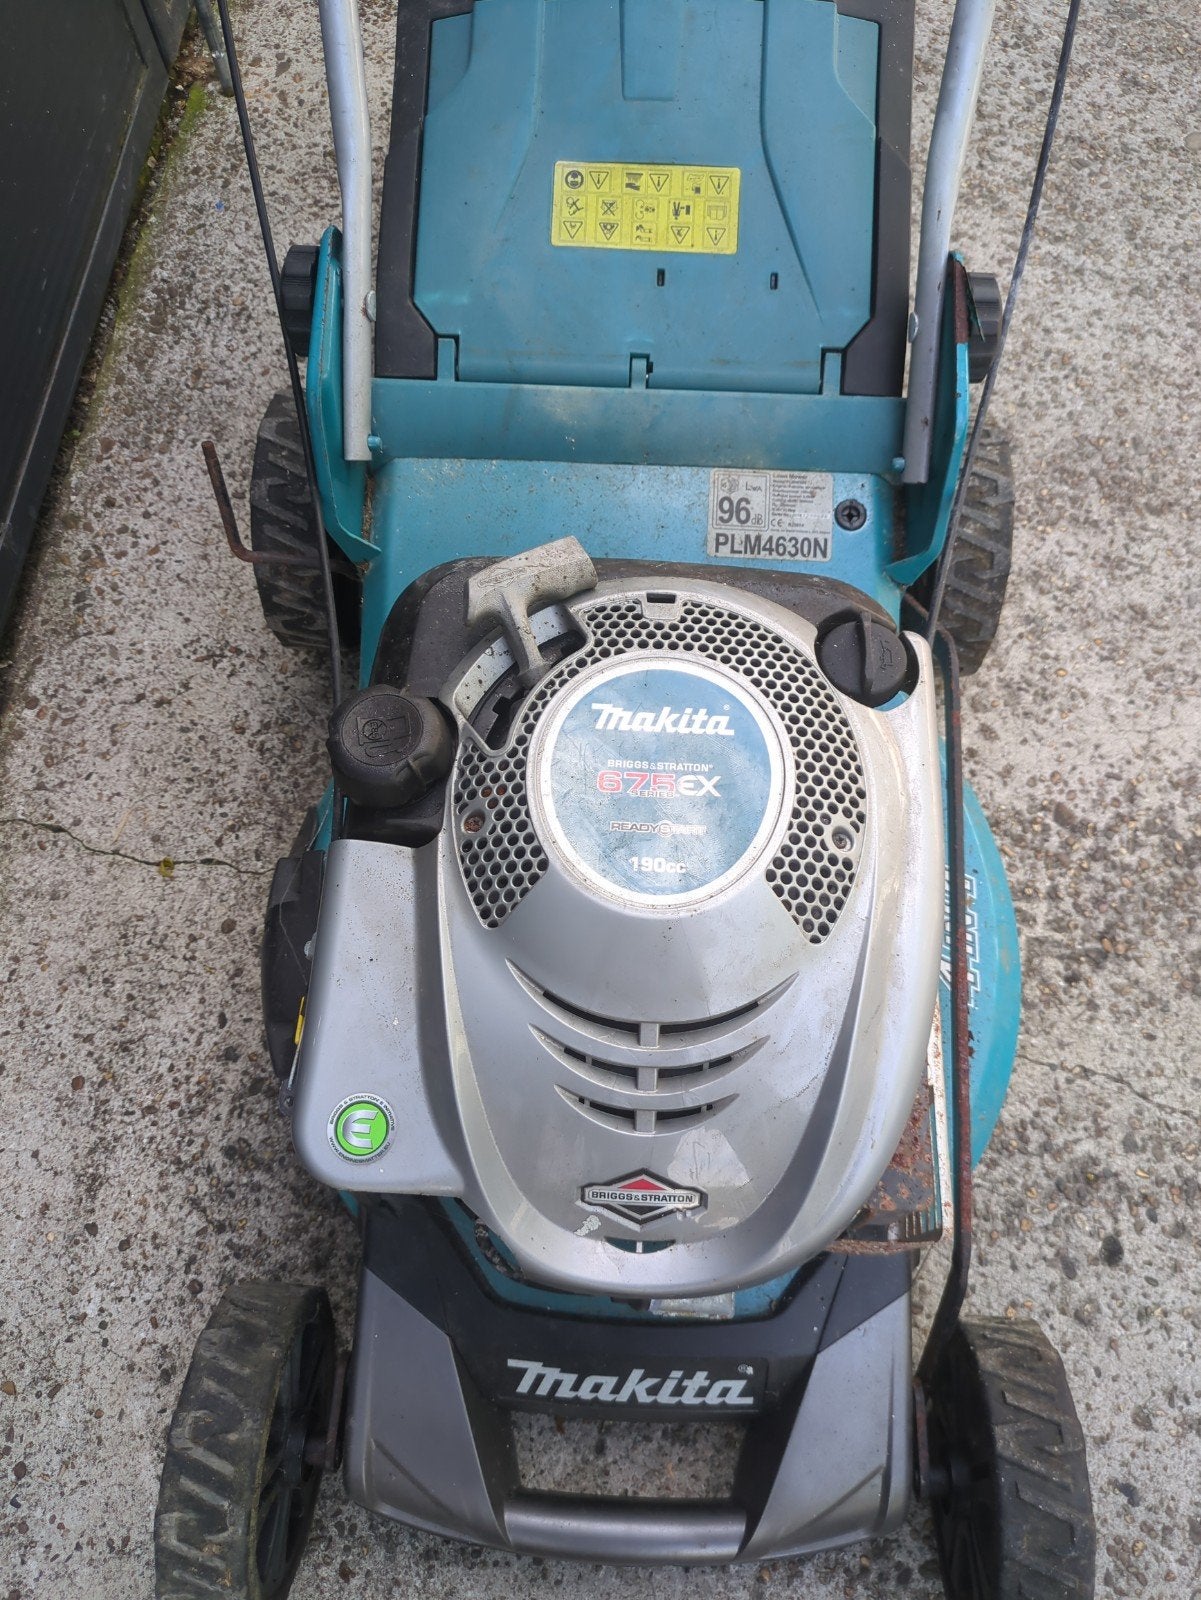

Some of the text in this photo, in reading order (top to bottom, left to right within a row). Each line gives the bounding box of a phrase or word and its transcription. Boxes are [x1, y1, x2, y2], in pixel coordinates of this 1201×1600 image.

[718, 496, 763, 525] 96 dB
[714, 532, 828, 559] PLM4630N
[591, 702, 735, 736] Makita
[629, 856, 687, 874] 190cc
[349, 1094, 380, 1102] STRATTON
[591, 1190, 693, 1203] BRIGGS&STRATTON
[506, 1358, 754, 1405] Makita
